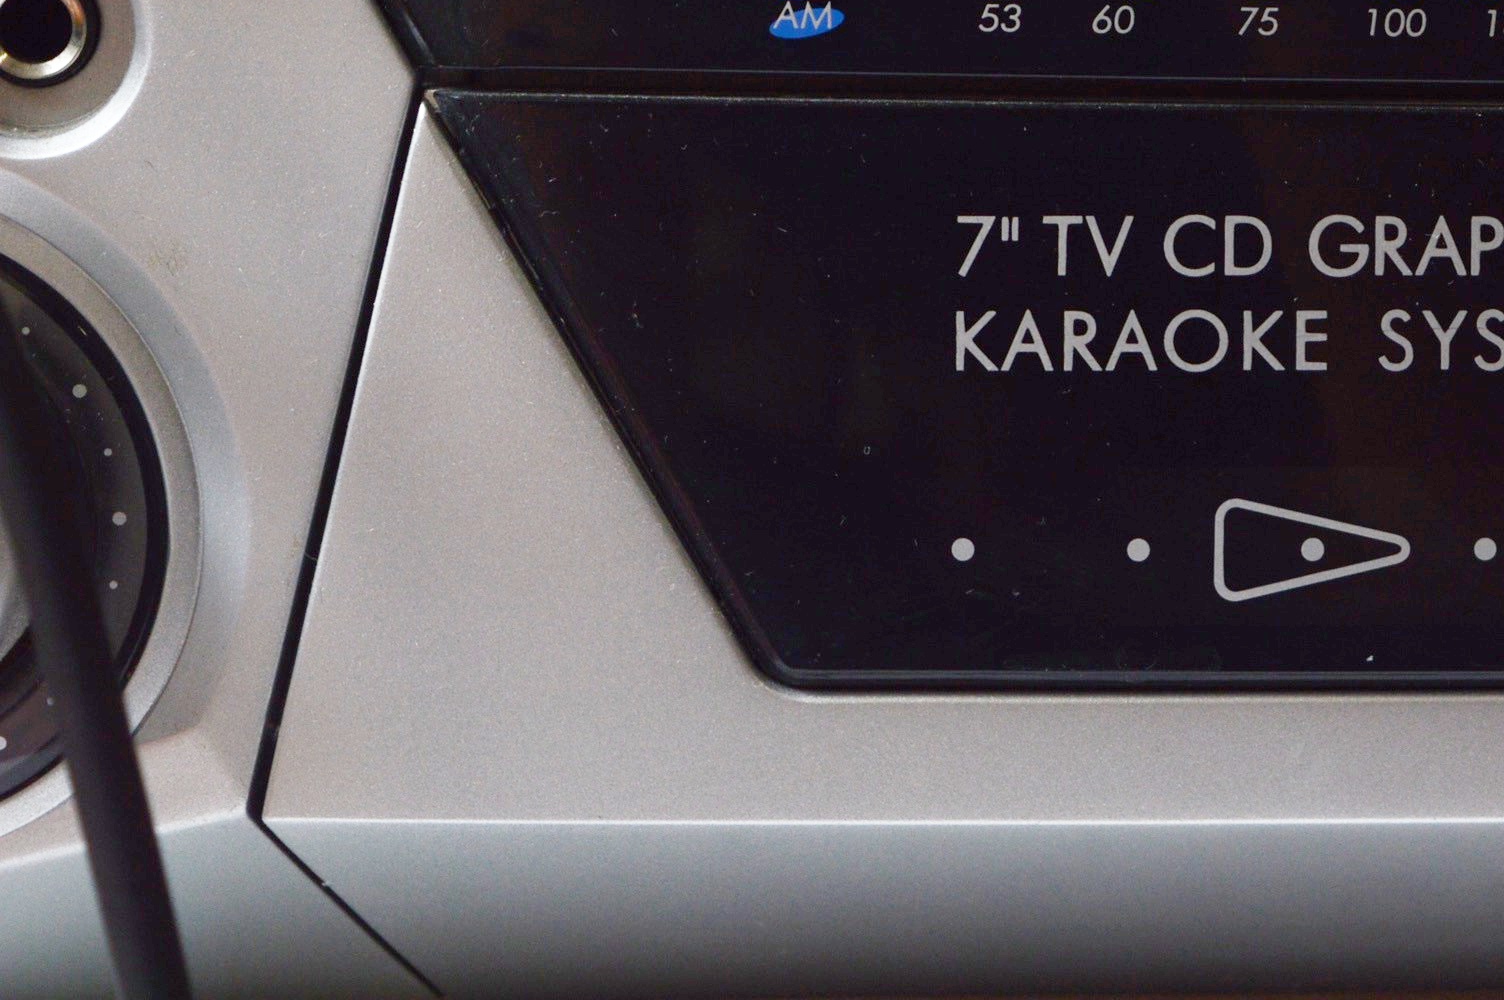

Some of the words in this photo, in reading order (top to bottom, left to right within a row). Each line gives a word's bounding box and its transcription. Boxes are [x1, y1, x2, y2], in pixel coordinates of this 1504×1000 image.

[774, 1, 832, 29] AM
[979, 4, 1021, 32] 53
[1092, 5, 1134, 33] 60
[1239, 7, 1278, 35] 75
[1369, 9, 1426, 37] 100
[957, 216, 1019, 277] 7"
[1043, 216, 1134, 277] TV
[1164, 214, 1272, 277] CD
[956, 310, 1327, 372] KARAOKE
